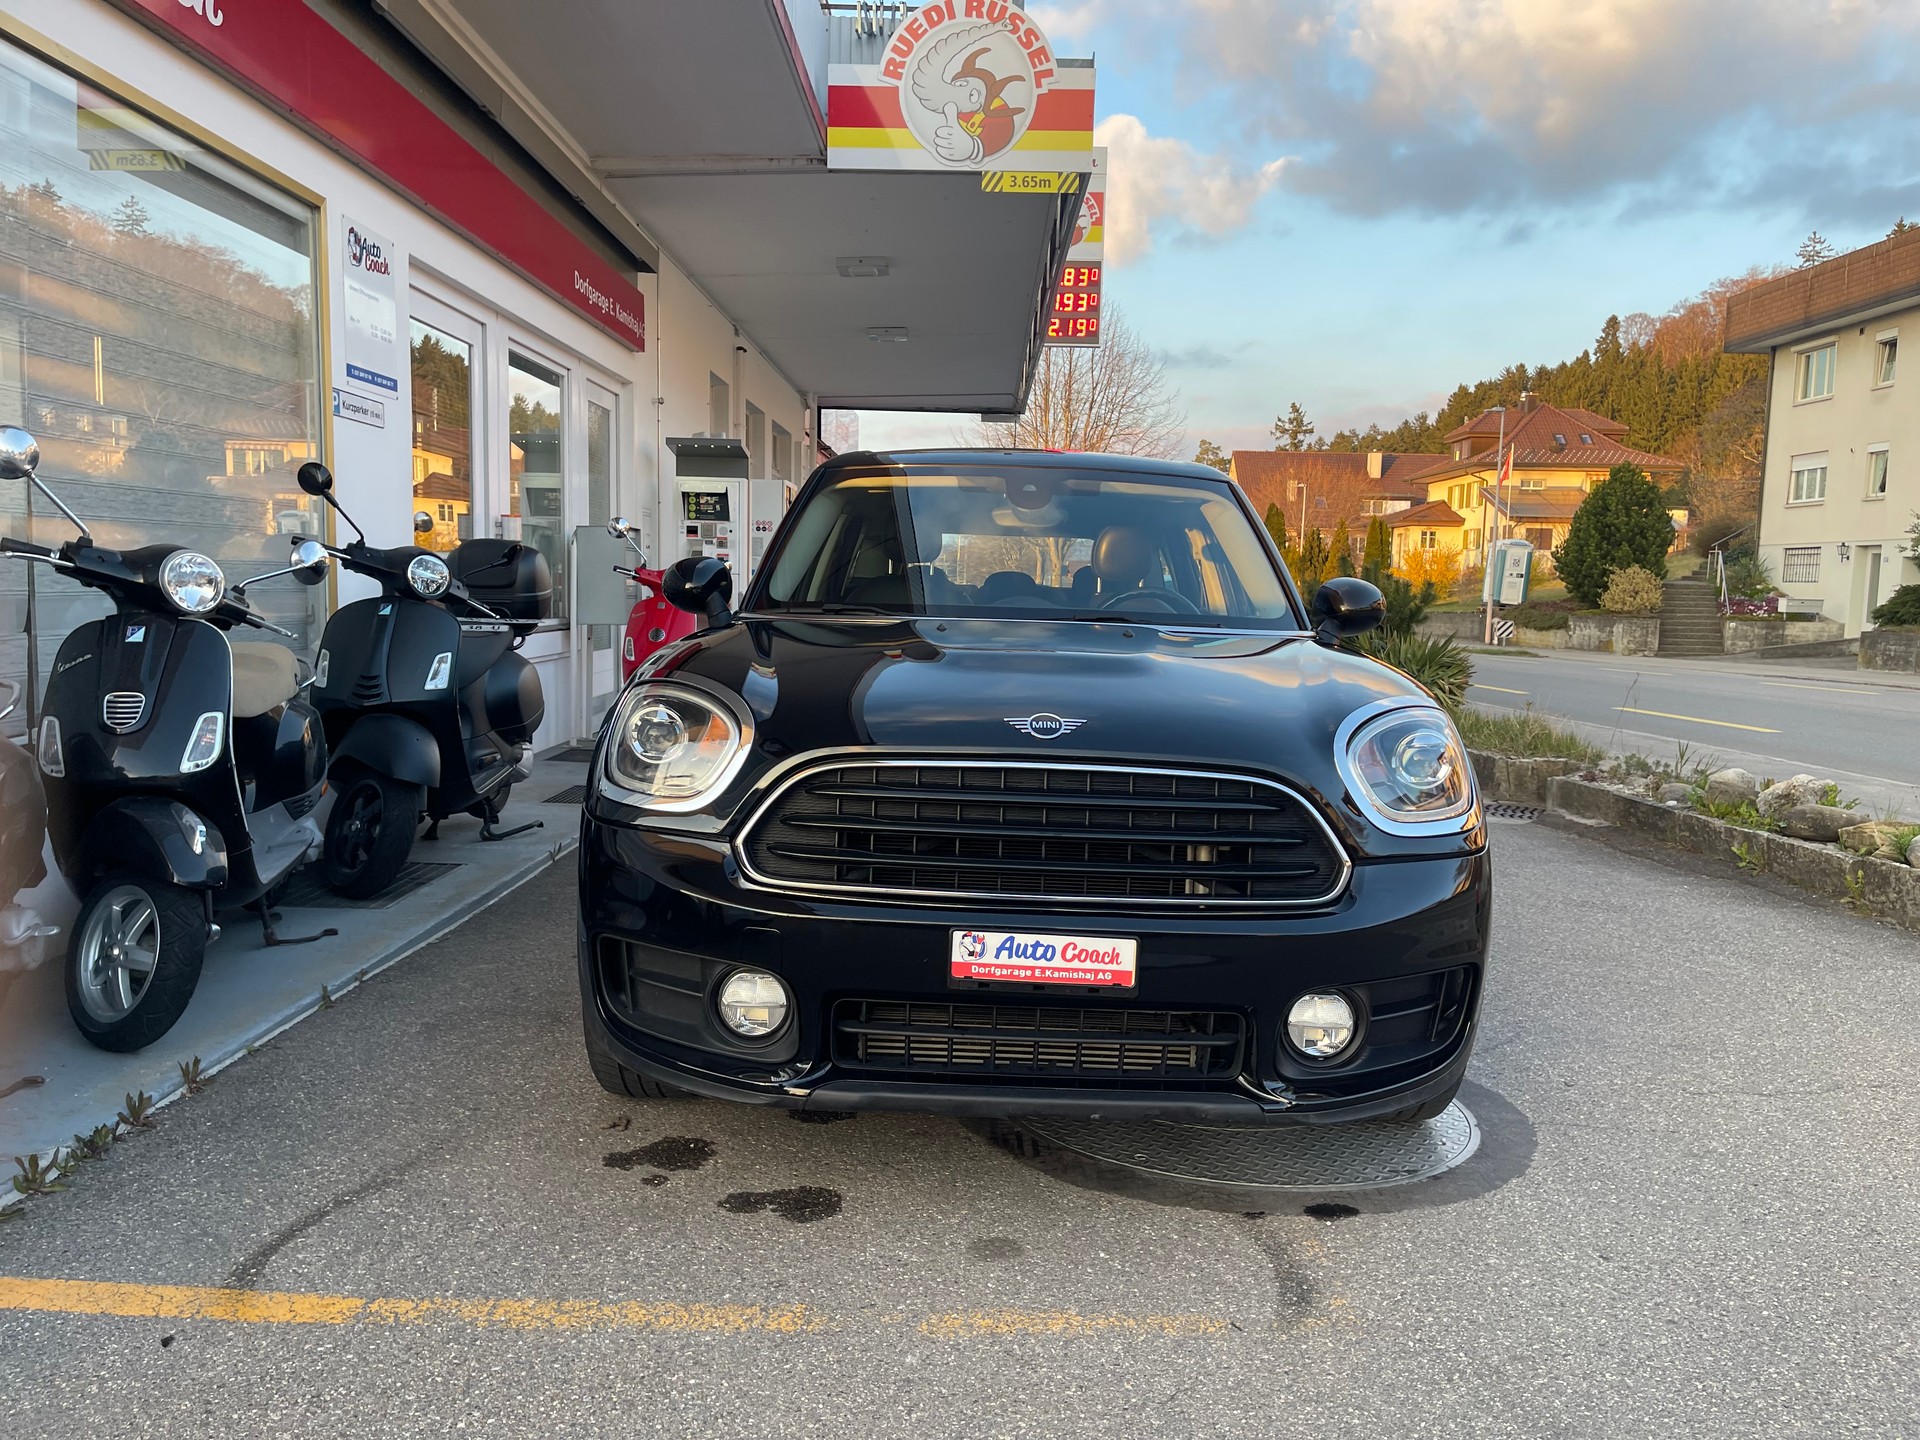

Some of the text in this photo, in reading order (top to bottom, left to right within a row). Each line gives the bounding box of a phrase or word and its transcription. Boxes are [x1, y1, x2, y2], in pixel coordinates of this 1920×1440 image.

[883, 0, 957, 81] RUEDI
[1009, 175, 1051, 188] 3.65m
[1083, 196, 1098, 222] SEL
[361, 237, 381, 259] Auto
[365, 253, 390, 276] Coach
[1060, 267, 1099, 287] .830
[574, 270, 609, 314] Dorfgarage
[615, 302, 639, 338] Kamishaj
[1055, 292, 1098, 312] 1.930
[1047, 318, 1097, 337] 2.190
[342, 399, 369, 415] Kurzparker
[1032, 721, 1060, 729] MINI
[994, 935, 1122, 965] Auto Coach
[971, 965, 1032, 977] Dorfgarage
[1097, 972, 1113, 980] AG
